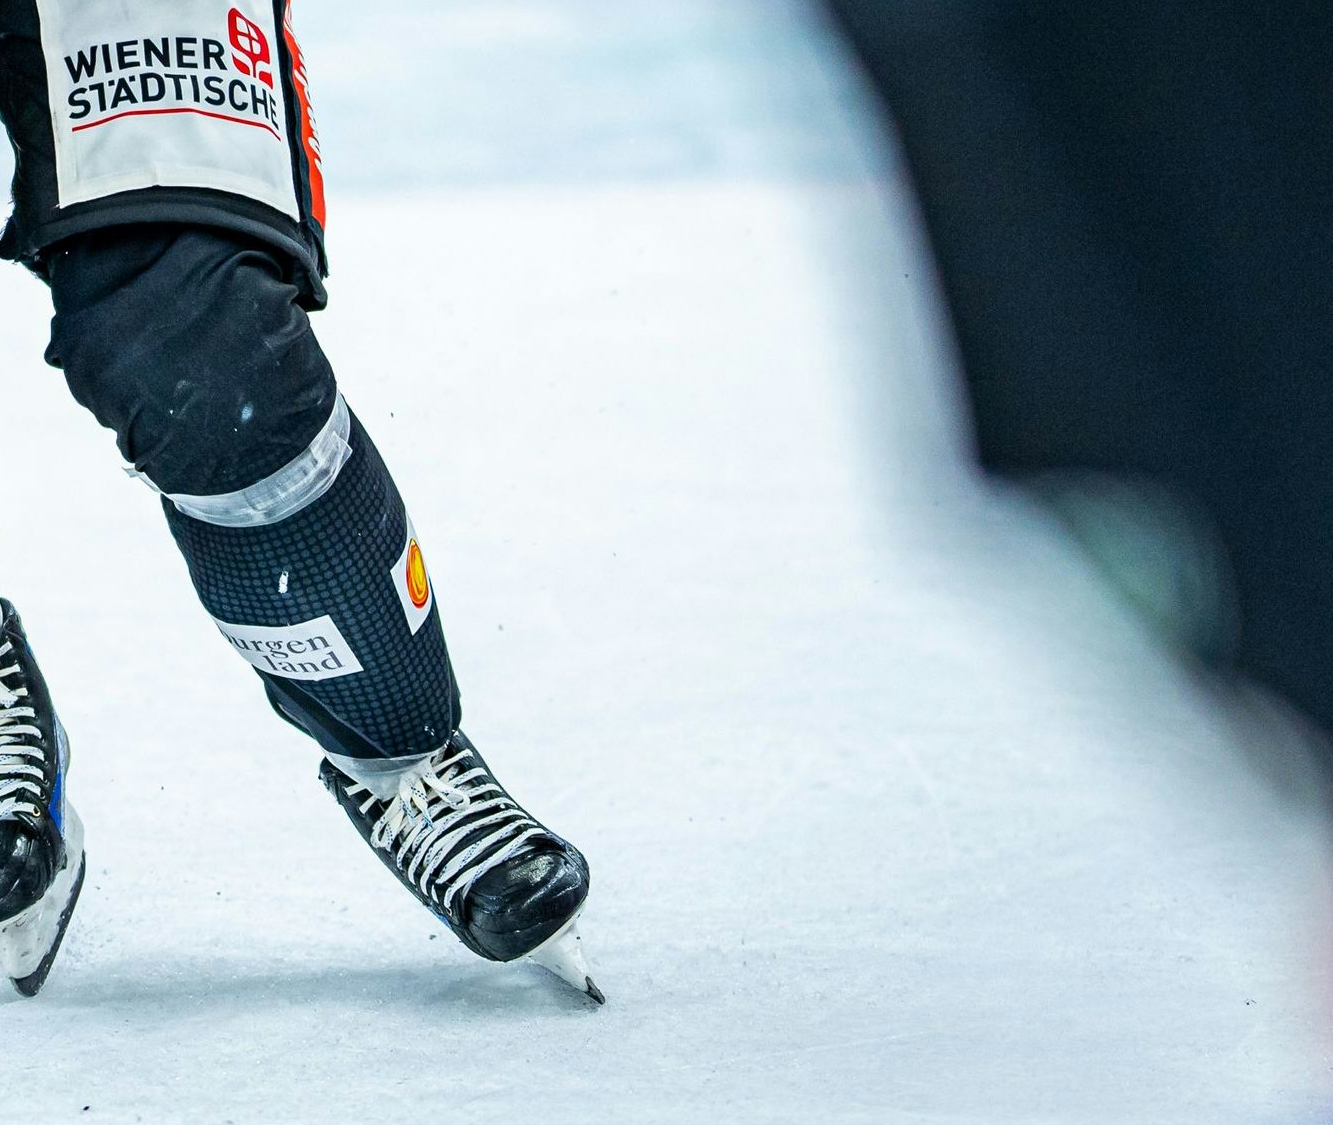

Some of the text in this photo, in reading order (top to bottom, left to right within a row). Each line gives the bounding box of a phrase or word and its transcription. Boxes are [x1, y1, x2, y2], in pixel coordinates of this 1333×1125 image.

[65, 36, 228, 84] WIENER
[68, 73, 280, 130] STÄDTISCHE
[263, 651, 346, 673] land
